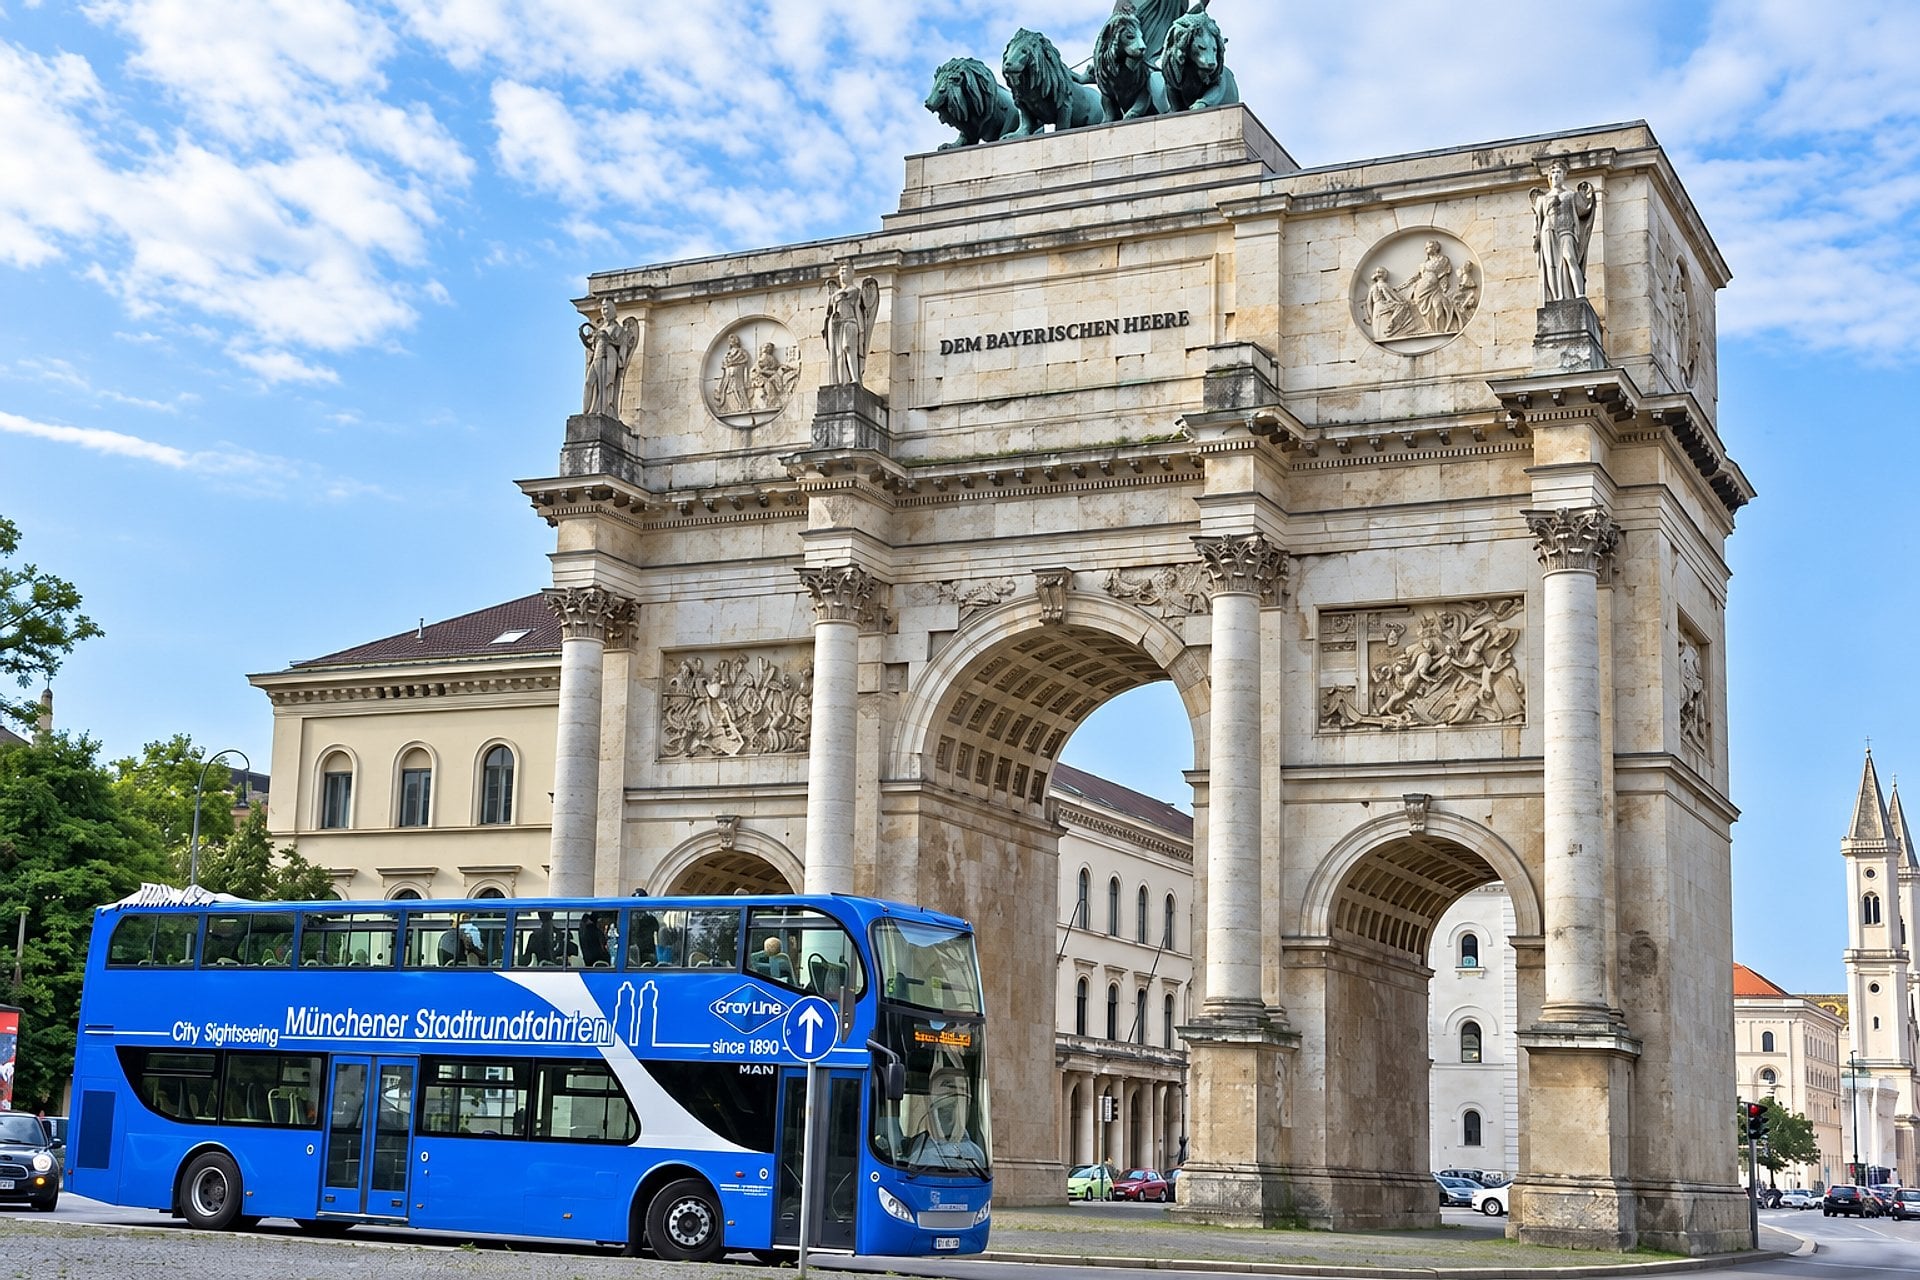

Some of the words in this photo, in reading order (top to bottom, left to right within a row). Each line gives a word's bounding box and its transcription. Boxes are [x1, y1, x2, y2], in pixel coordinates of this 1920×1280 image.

[939, 335, 982, 356] DEM
[986, 318, 1120, 350] BAYERISCHEN
[1123, 310, 1190, 334] HEERE
[172, 1021, 200, 1045] City
[204, 1022, 279, 1047] Sightseeing
[285, 1006, 409, 1038] Münchener
[414, 1008, 610, 1043] Stadtrundfahrten
[712, 1038, 745, 1054] since
[748, 1039, 779, 1055] 1890
[739, 1064, 774, 1075] MAN
